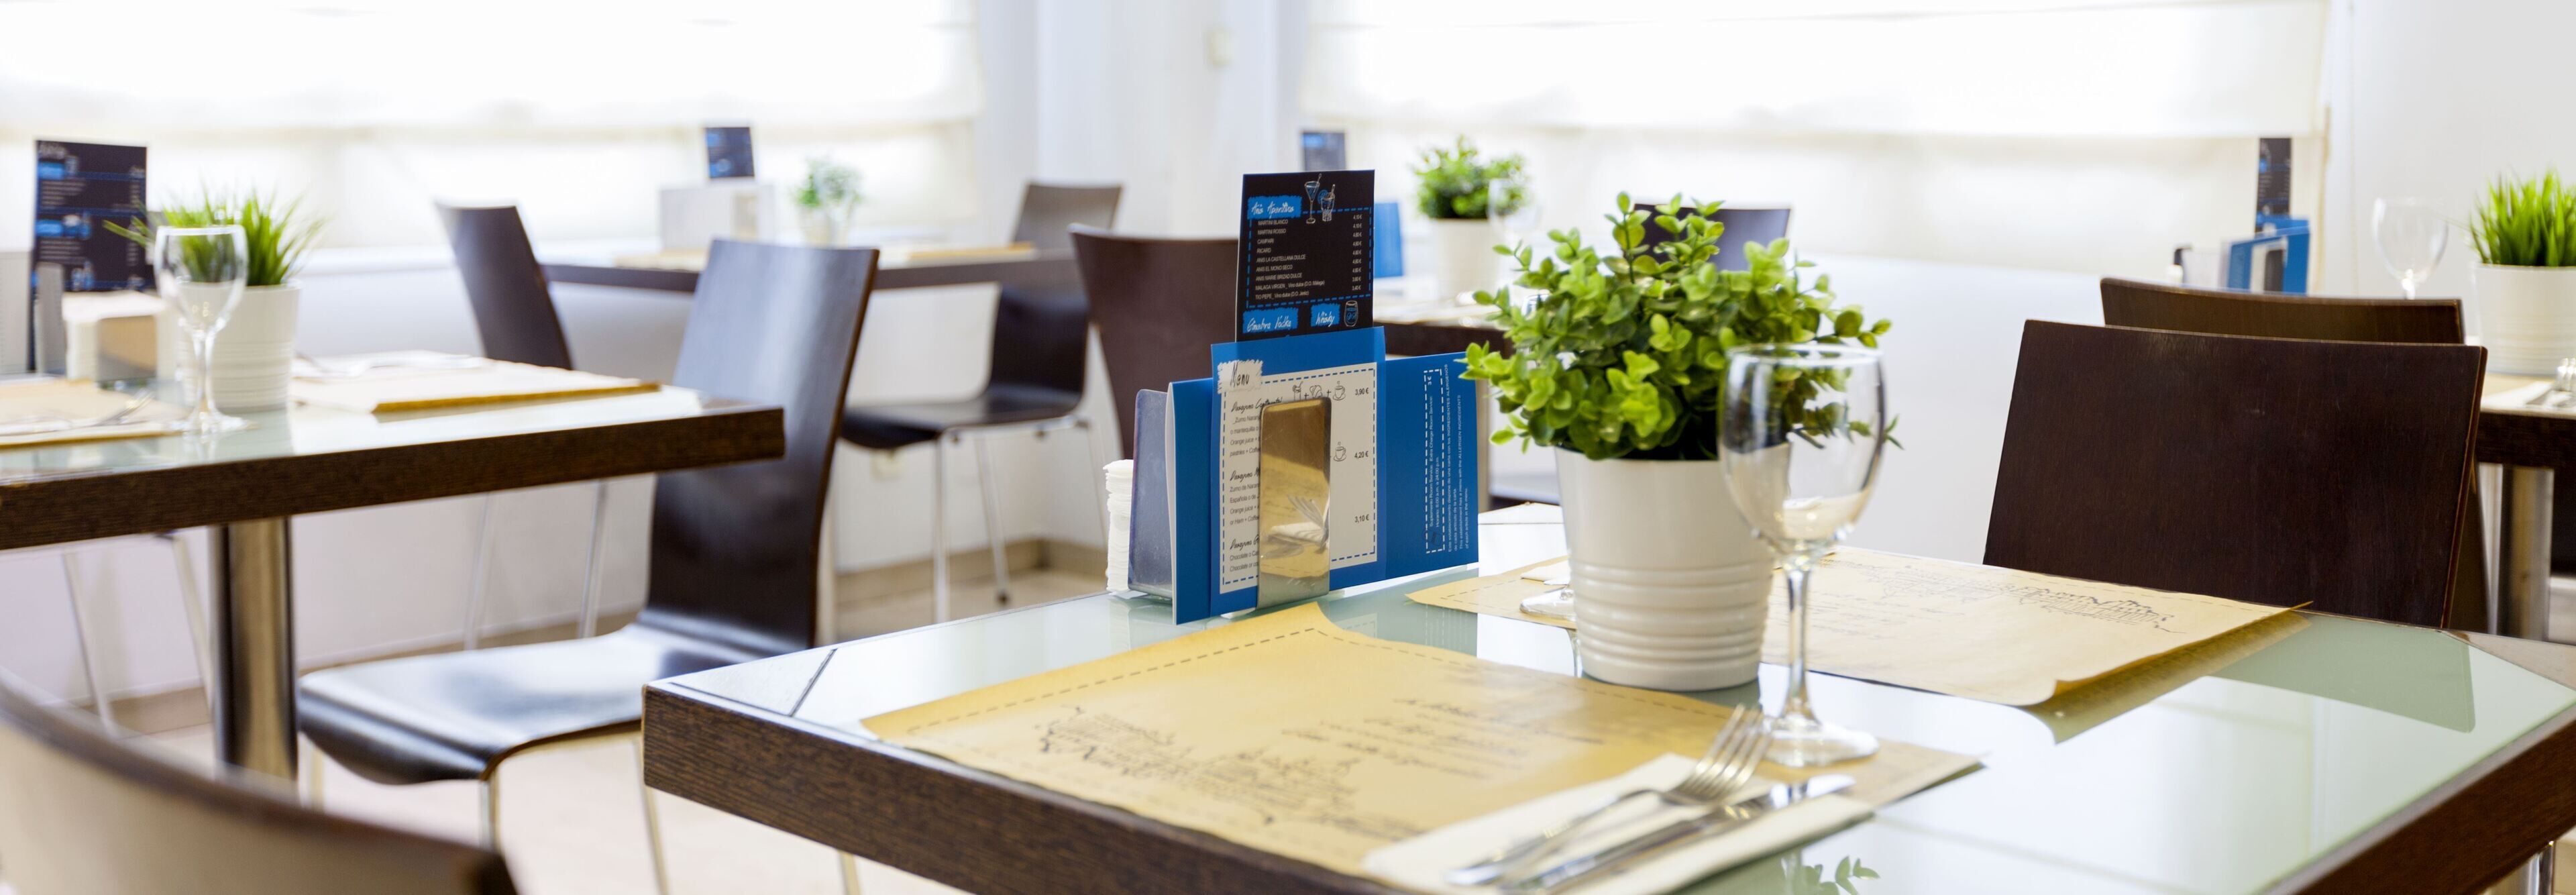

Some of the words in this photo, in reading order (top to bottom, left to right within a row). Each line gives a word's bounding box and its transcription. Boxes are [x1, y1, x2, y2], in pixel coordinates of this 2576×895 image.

[1316, 311, 1335, 327] Whisky
[1246, 317, 1271, 332] Ginebra
[1230, 362, 1250, 387] Menu
[1354, 451, 1364, 459] 4,20
[1230, 470, 1252, 482] Desayuno
[1244, 505, 1253, 514] juice
[1354, 515, 1365, 523] 3,10
[1230, 539, 1252, 551] Desayuno
[1230, 553, 1248, 561] Chocolate
[1230, 563, 1248, 572] Chocolate
